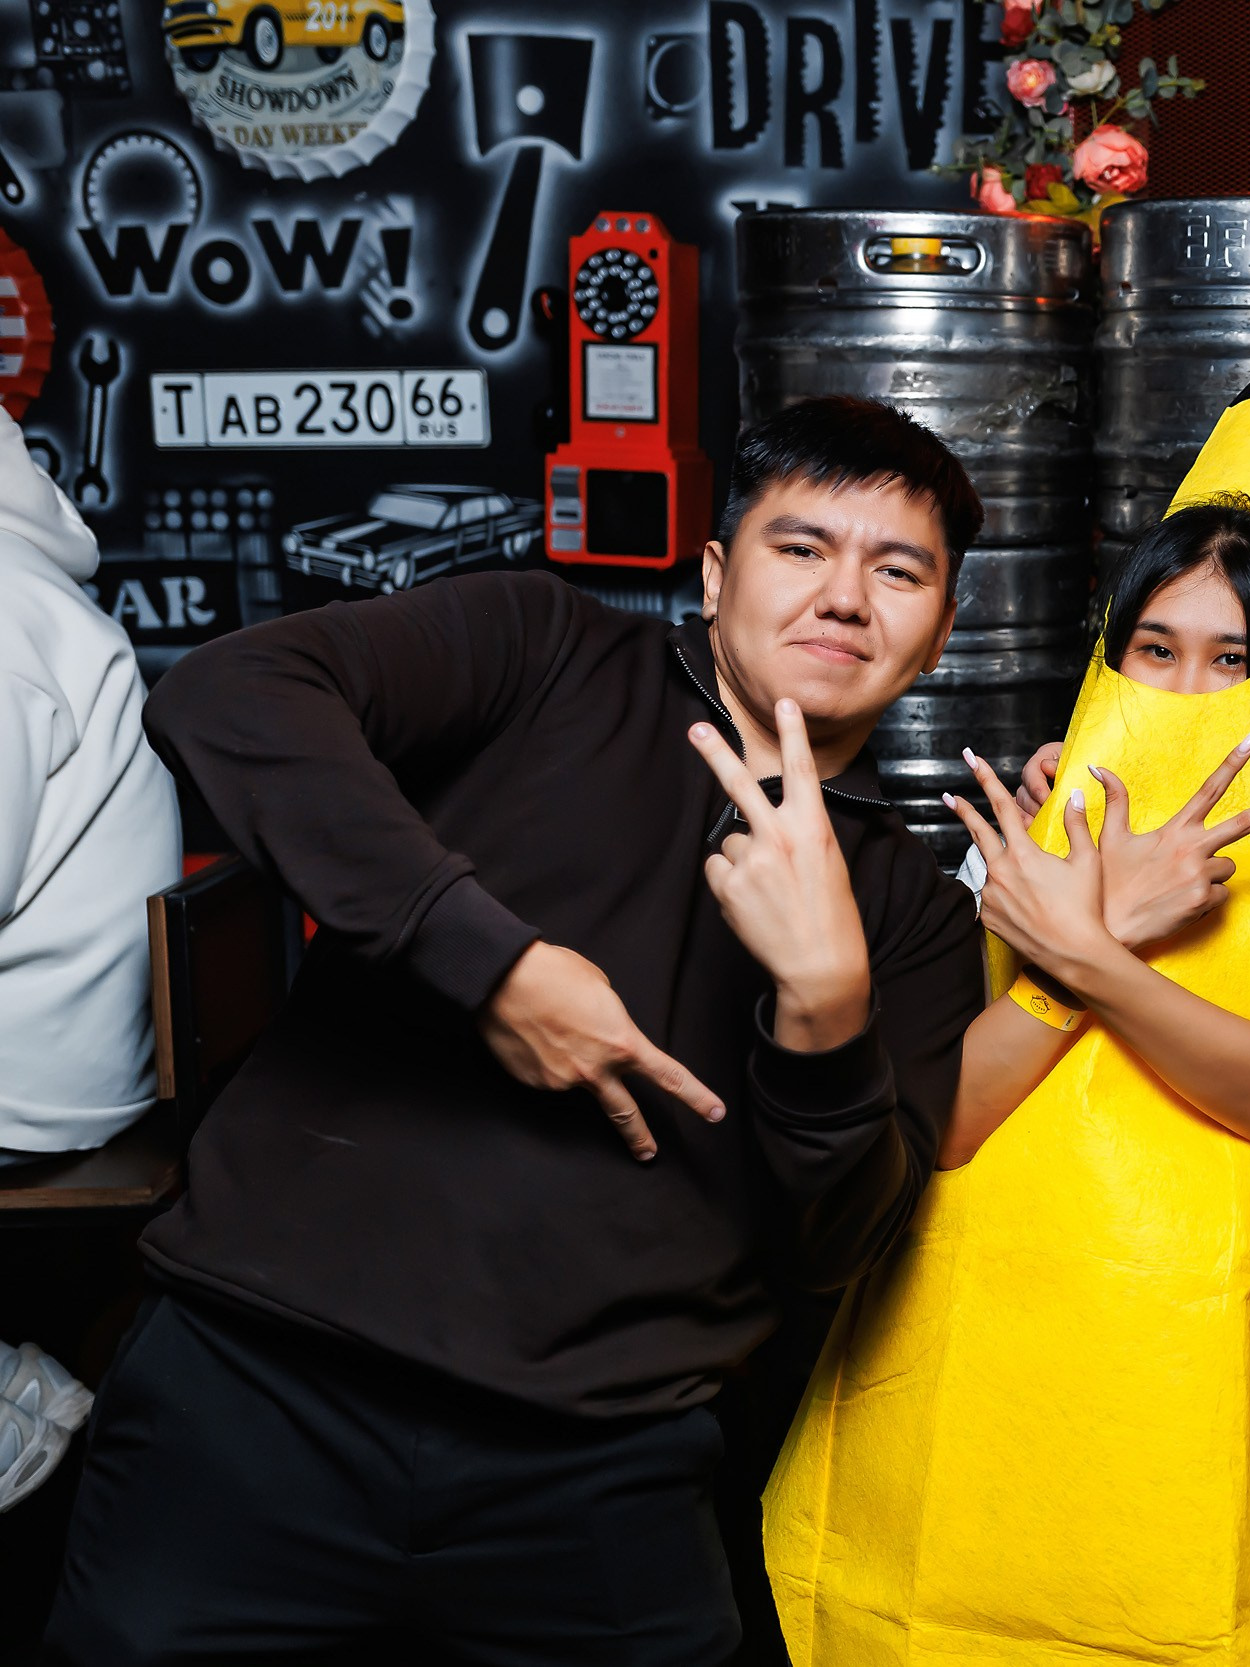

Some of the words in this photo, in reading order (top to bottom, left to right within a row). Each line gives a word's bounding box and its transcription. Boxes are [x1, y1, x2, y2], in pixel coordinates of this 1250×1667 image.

[305, 1, 348, 31] 201
[215, 70, 359, 113] SHOWDOWN
[708, 0, 1020, 171] DRIVE
[234, 125, 274, 148] DAY
[281, 122, 368, 146] WEEKE
[163, 385, 193, 436] T
[411, 377, 462, 417] 66
[418, 421, 458, 438] RUS
